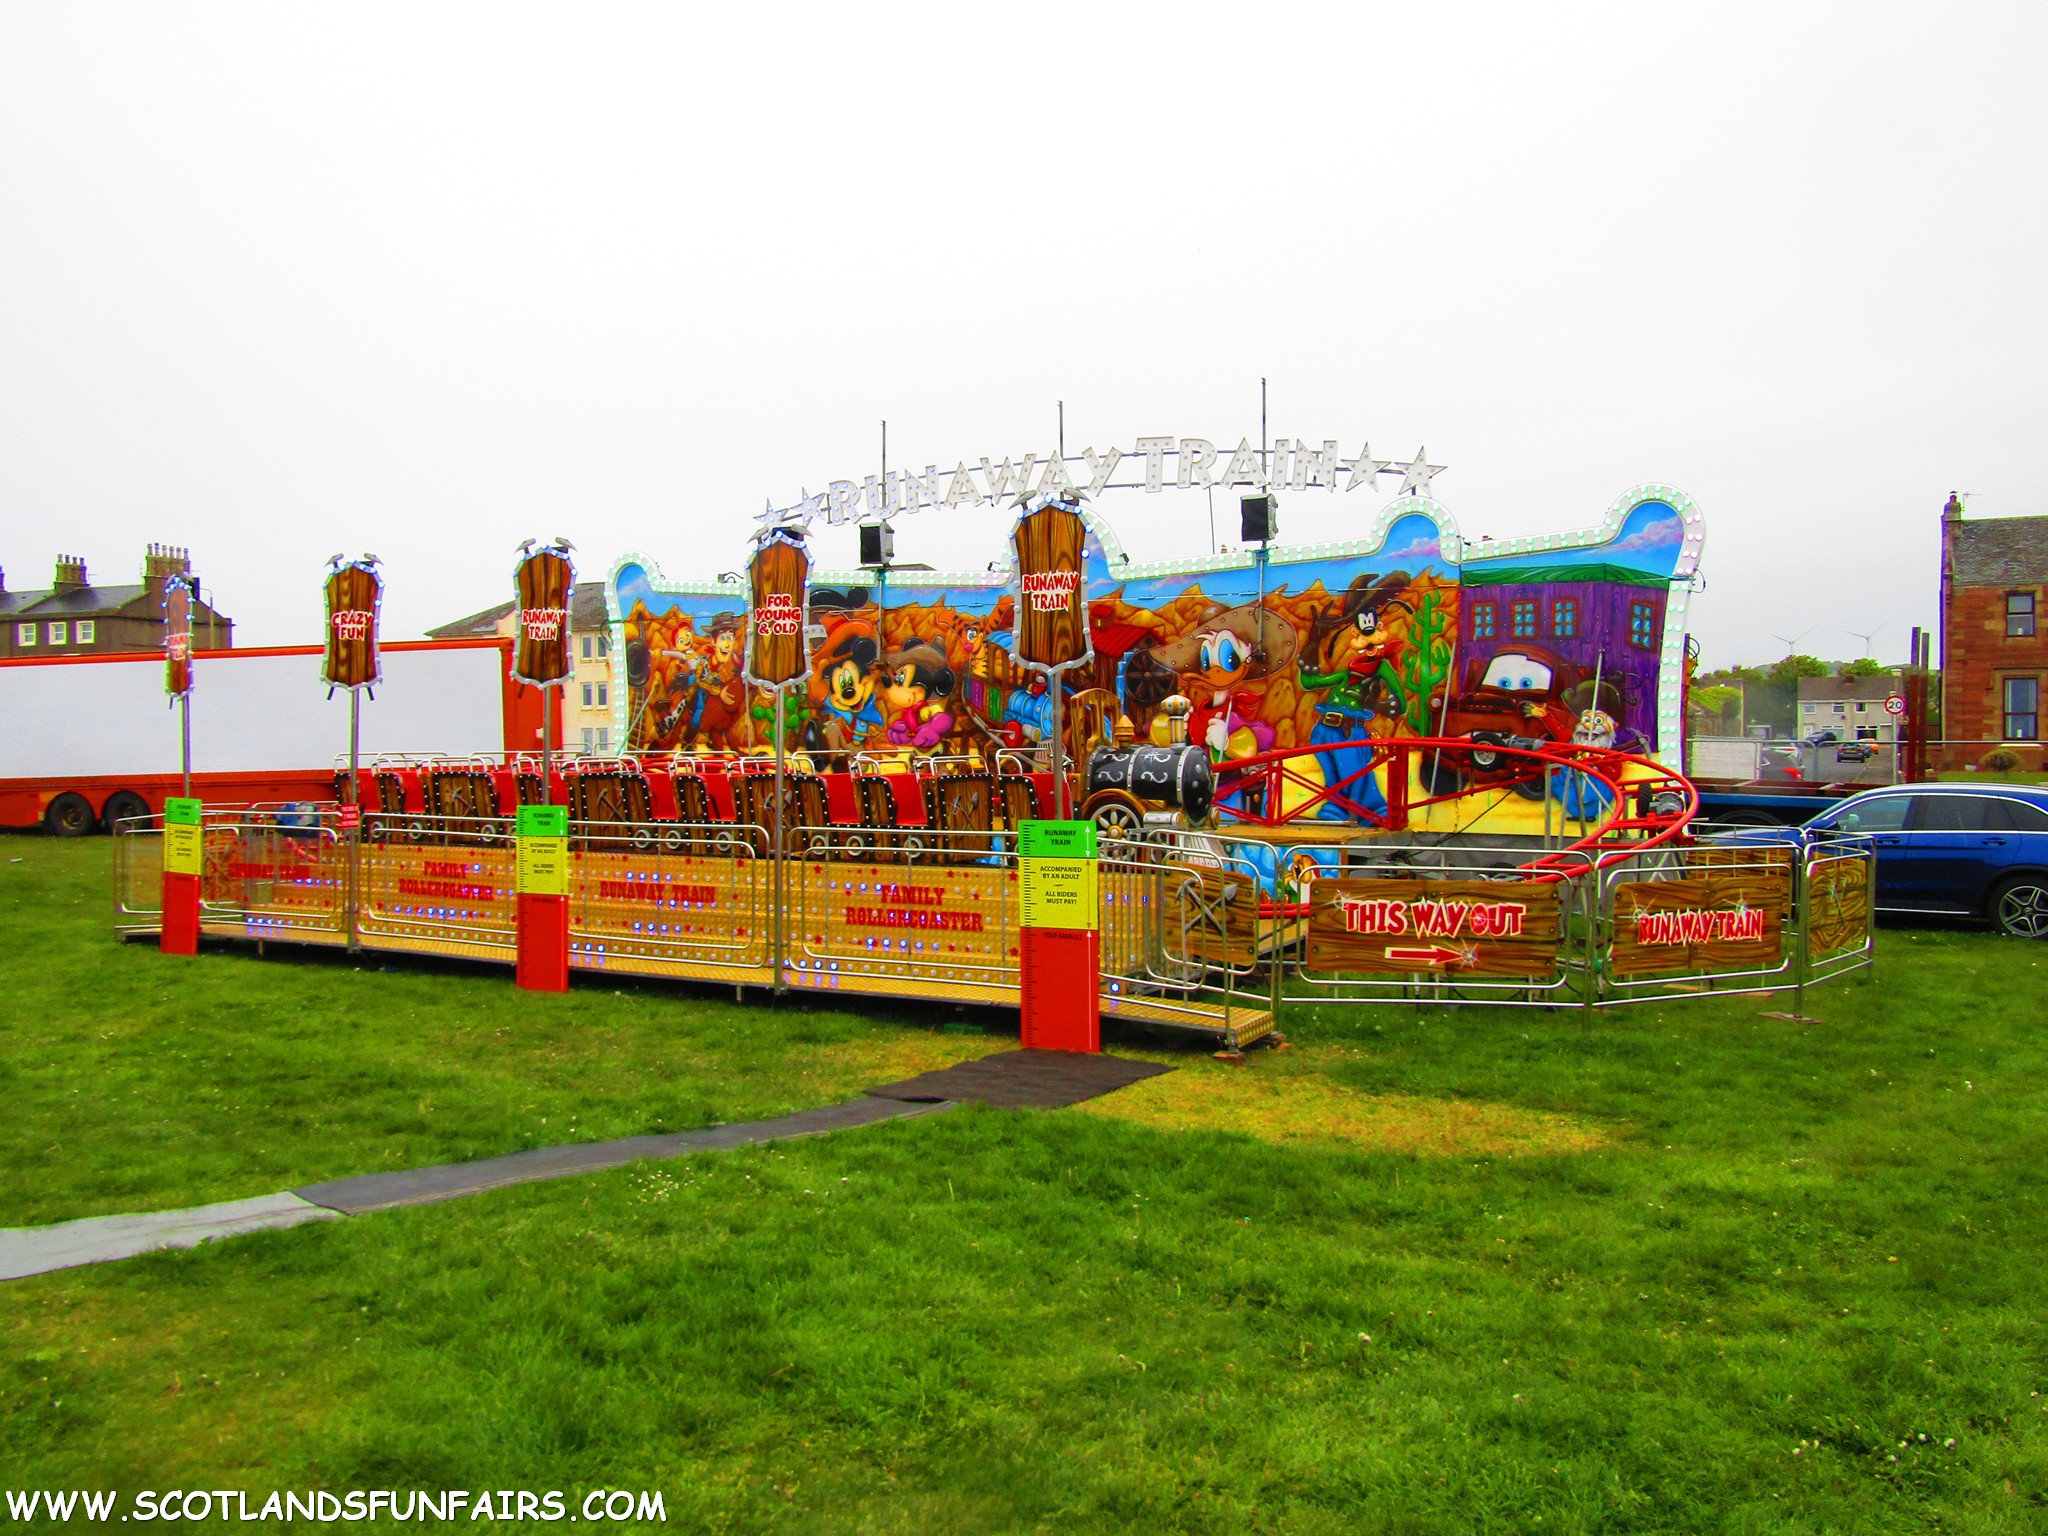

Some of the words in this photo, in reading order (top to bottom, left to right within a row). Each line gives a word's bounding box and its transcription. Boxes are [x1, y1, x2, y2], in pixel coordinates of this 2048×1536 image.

[829, 446, 1124, 526] RUNAWAY
[1135, 436, 1338, 493] TRAIN
[1022, 569, 1080, 593] RUNAWAY
[767, 594, 792, 608] FOR
[1031, 591, 1069, 612] TRAIN
[331, 609, 374, 628] CRAZY
[521, 607, 566, 626] RUNAWAY
[754, 607, 802, 623] YOUNG
[339, 626, 365, 641] FUN
[528, 624, 557, 641] TRAIN
[758, 622, 772, 636] &
[773, 621, 798, 636] OLD
[1888, 701, 1903, 709] 20
[1044, 829, 1077, 837] RUNAWAY
[1051, 838, 1071, 846] TRAIN
[424, 861, 467, 879] FAMILY
[398, 878, 495, 901] ROLLERCOASTER
[600, 880, 664, 901] RUNAWAY
[672, 884, 716, 904] TRAIN
[881, 884, 945, 905] FAMILY
[845, 907, 984, 932] ROLLERCOASTER
[1342, 898, 1408, 935] THIS
[1411, 896, 1469, 939] WAY
[1470, 902, 1527, 937] OUT
[1638, 907, 1716, 947] RUNAWAY
[1716, 909, 1765, 942] TRAIN
[1042, 931, 1058, 939] TOO
